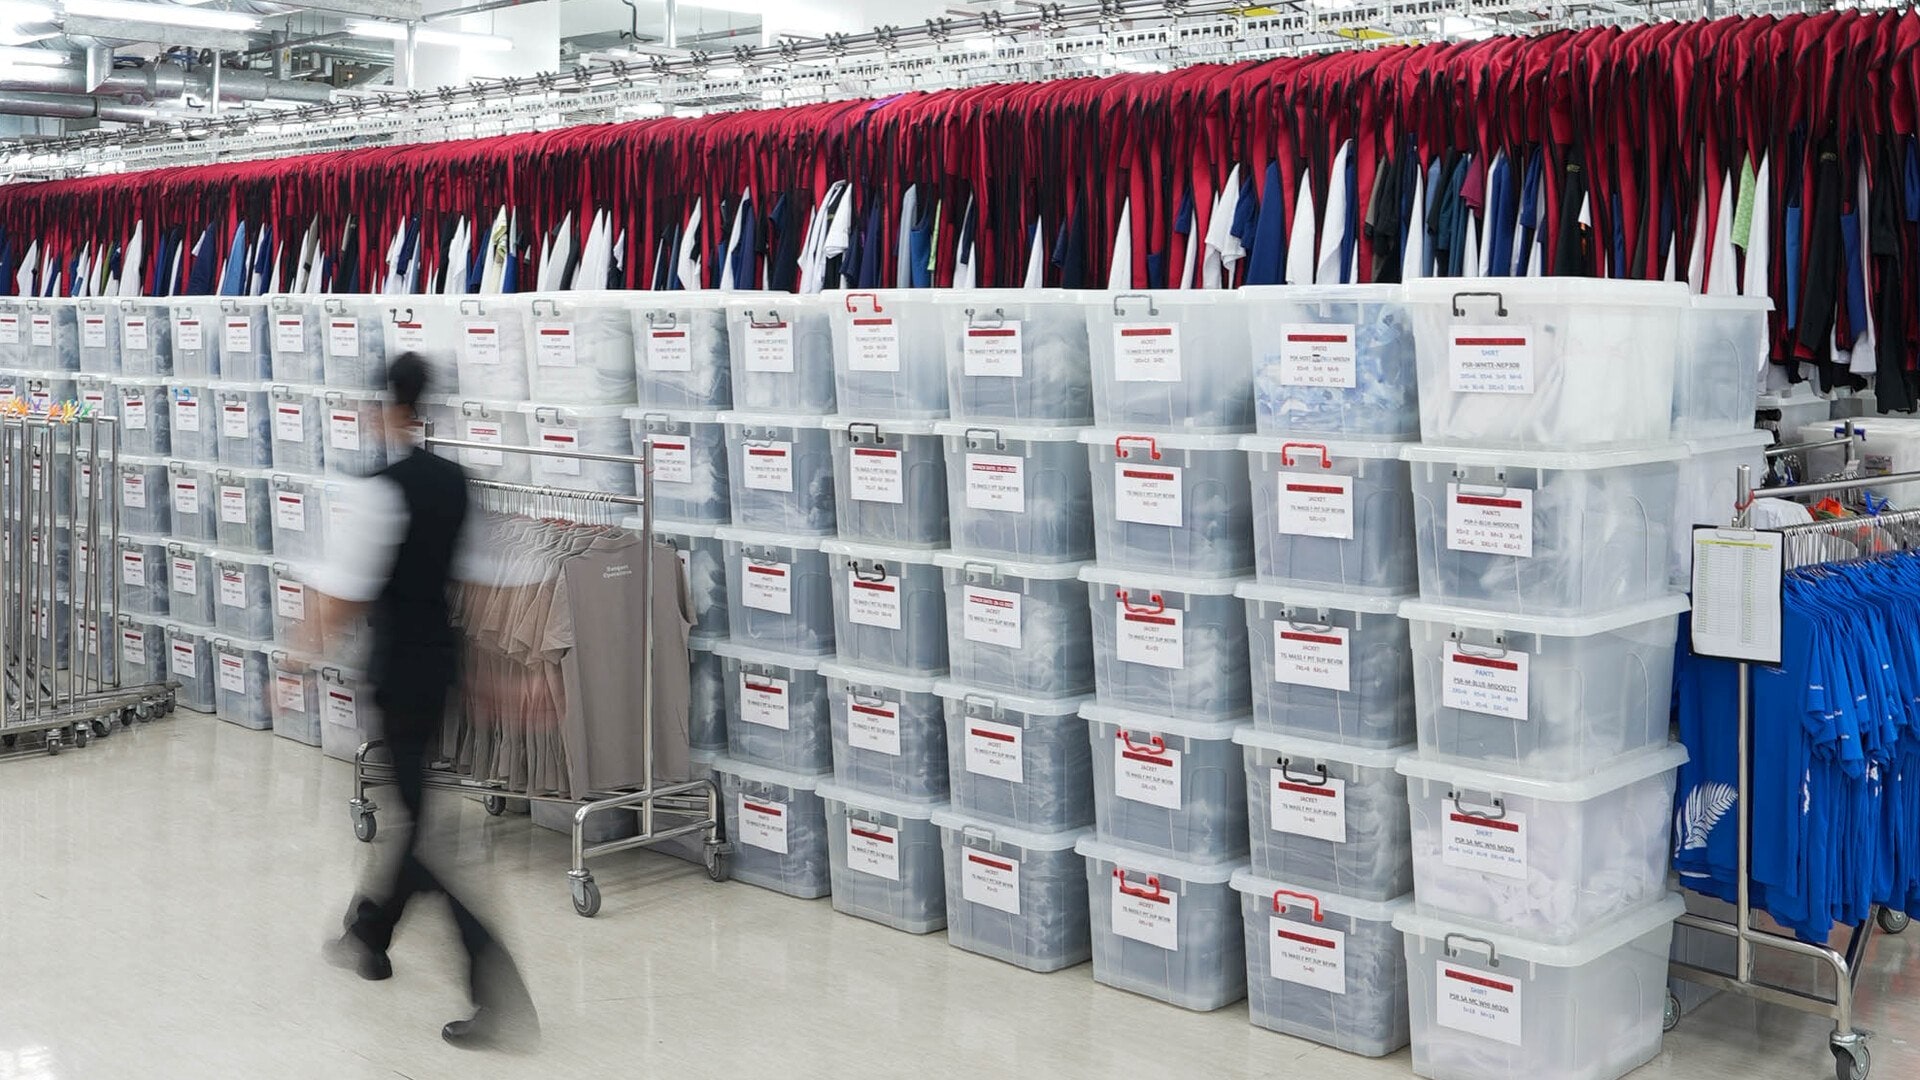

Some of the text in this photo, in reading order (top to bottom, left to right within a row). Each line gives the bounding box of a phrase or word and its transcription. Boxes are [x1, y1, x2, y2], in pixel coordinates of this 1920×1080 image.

[1474, 668, 1494, 677] PANTS
[1140, 764, 1156, 772] JACKET
[1300, 795, 1317, 803] JACKET
[1299, 945, 1316, 953] JACKET
